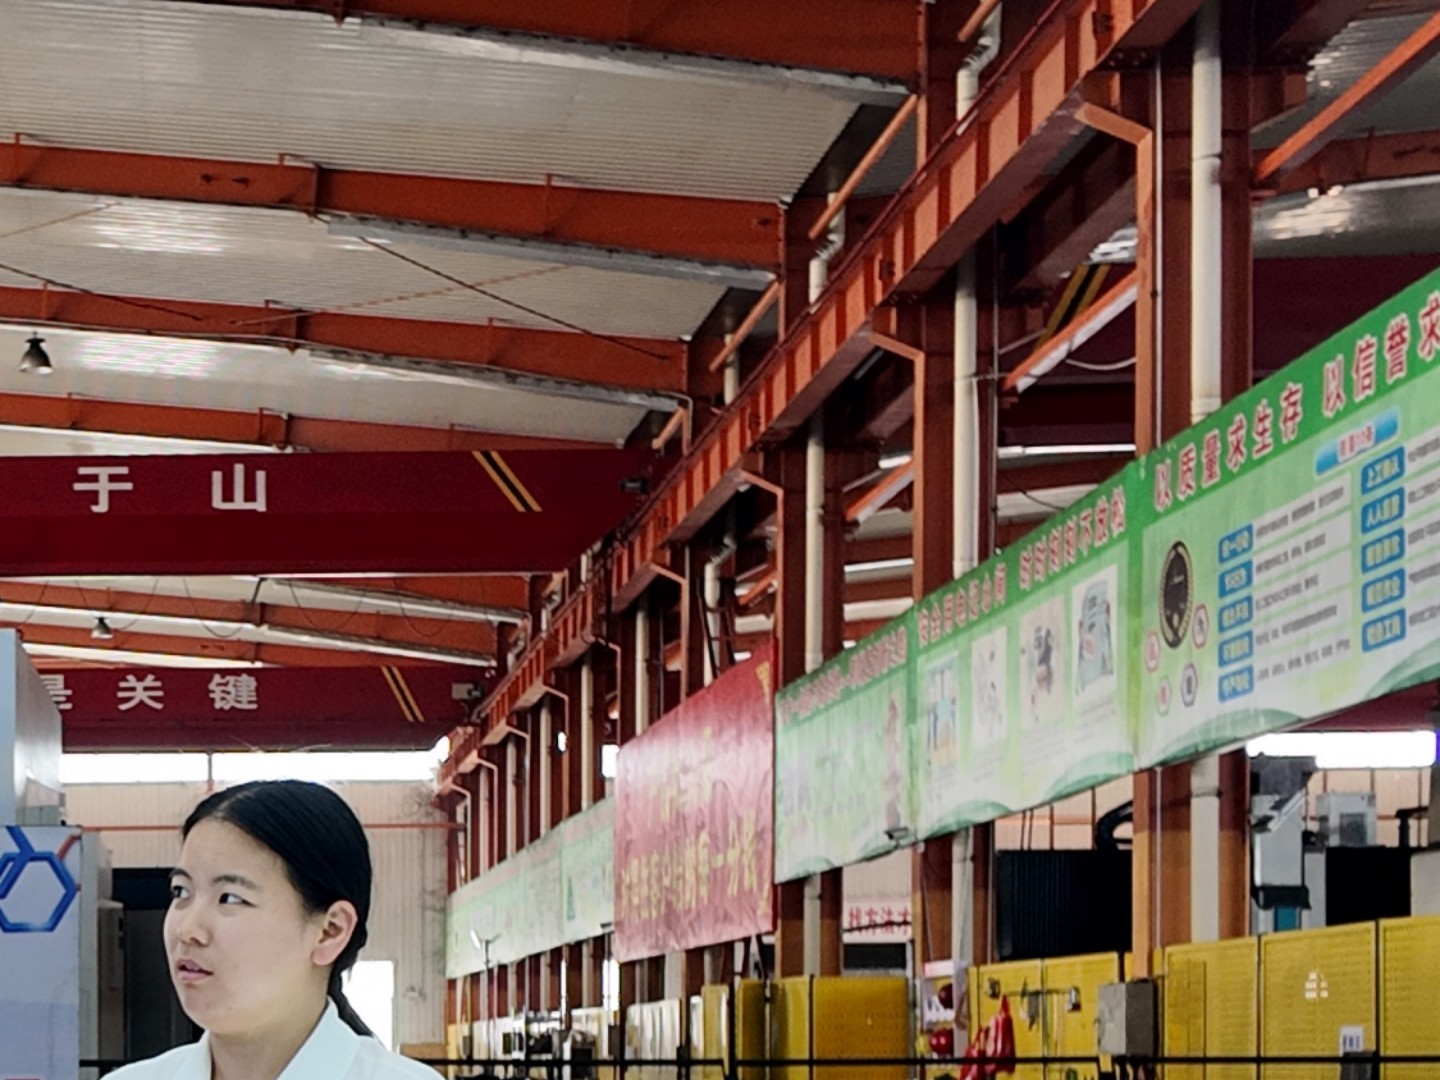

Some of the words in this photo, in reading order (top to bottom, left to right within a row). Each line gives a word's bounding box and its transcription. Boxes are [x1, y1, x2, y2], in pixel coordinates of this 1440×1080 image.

[1154, 382, 1303, 513] 以质量求生存
[1322, 290, 1440, 418] 以信誉求
